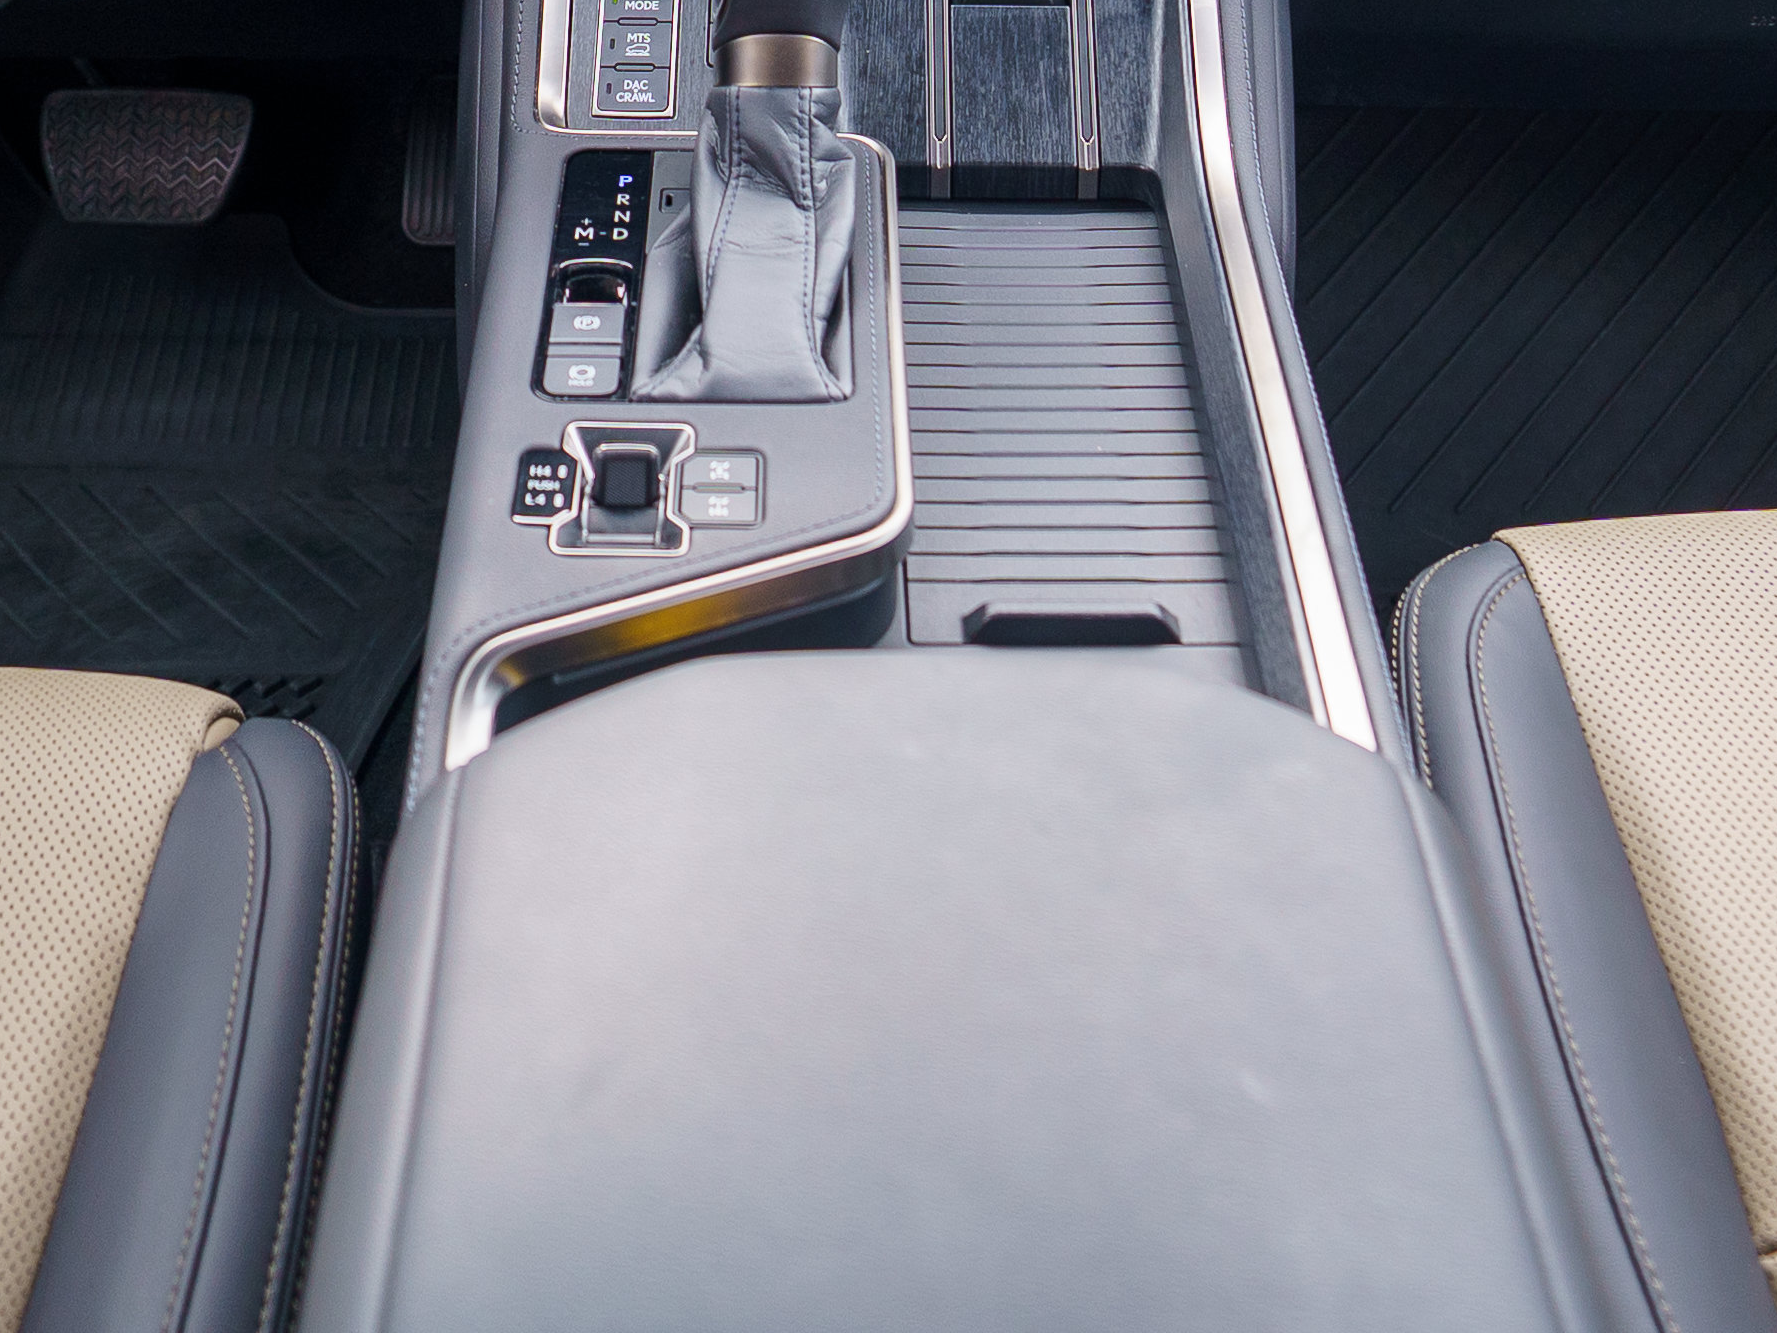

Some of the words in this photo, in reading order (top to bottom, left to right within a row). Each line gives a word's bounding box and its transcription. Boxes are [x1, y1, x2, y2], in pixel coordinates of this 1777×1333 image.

[625, 1, 659, 10] MODE
[627, 33, 651, 43] MTS
[624, 80, 648, 90] DAC
[616, 93, 655, 103] CRAWL
[618, 175, 633, 187] P
[616, 194, 630, 206] R
[614, 211, 630, 222] N
[574, 227, 593, 240] M
[613, 228, 628, 240] D
